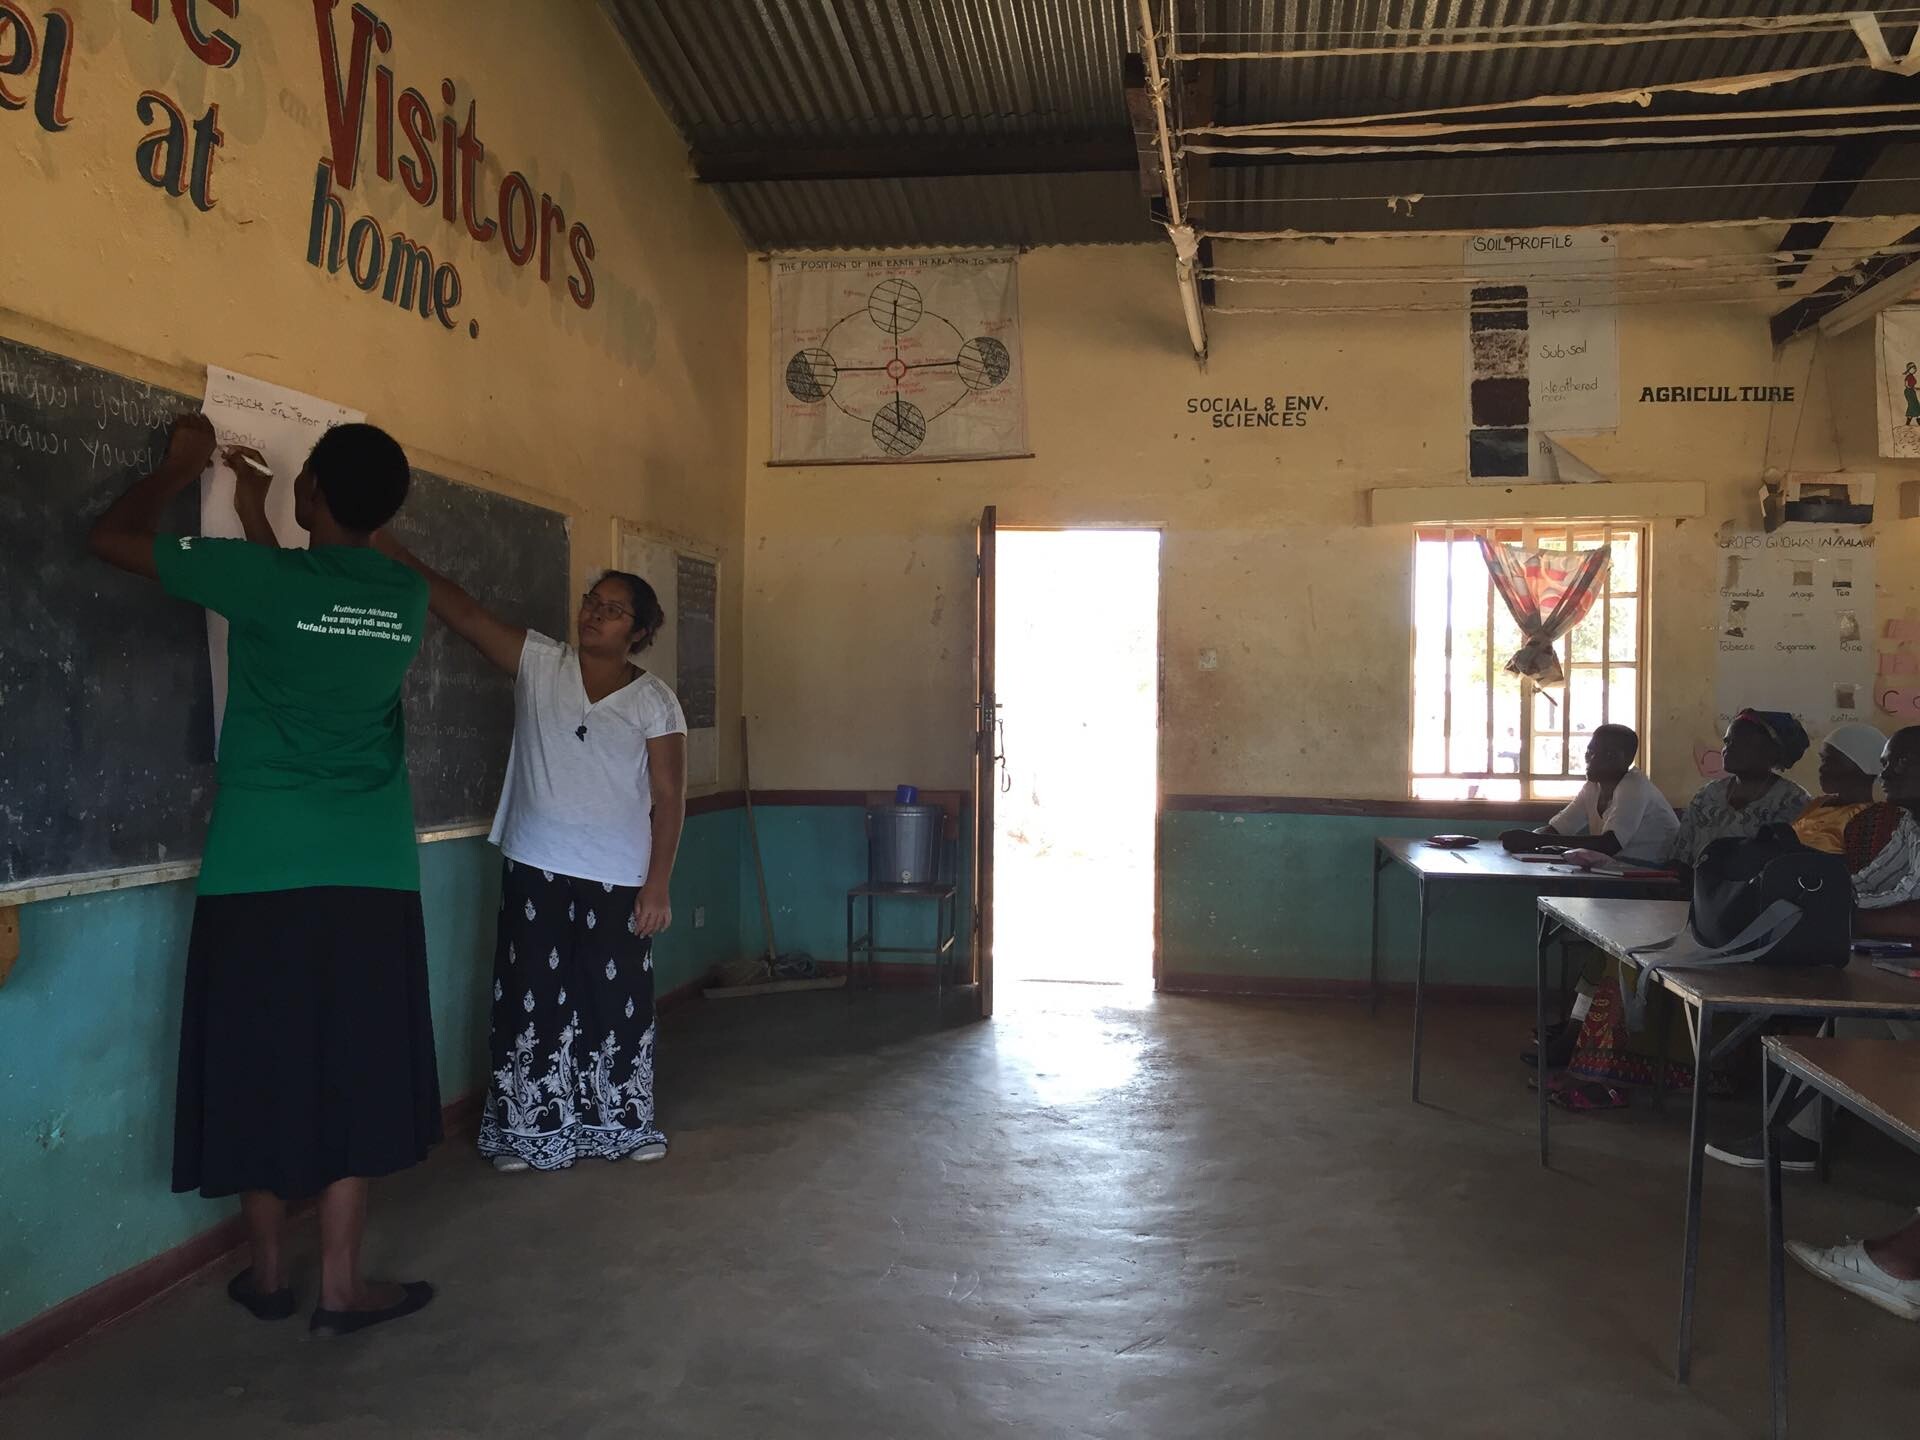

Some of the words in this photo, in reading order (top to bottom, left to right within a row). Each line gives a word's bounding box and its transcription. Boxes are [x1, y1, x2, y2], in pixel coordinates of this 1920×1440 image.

[313, 0, 595, 309] Visitors
[135, 90, 224, 211] at
[307, 157, 481, 338] home.
[1474, 236, 1507, 252] SOIL
[1509, 234, 1573, 252] PROFILE
[779, 263, 796, 273] THE
[800, 261, 847, 271] POSITION
[851, 261, 862, 270] OF
[886, 259, 915, 269] EARTH
[918, 258, 928, 267] IN
[1541, 376, 1599, 394] Weathered
[1638, 385, 1796, 403] AGRICULTURE
[1186, 396, 1258, 414] SOCIAL
[1263, 396, 1277, 412] &
[1285, 395, 1329, 411] ENV.
[1211, 411, 1308, 429] SCIENCES
[1719, 535, 1762, 549] CROPS
[1835, 588, 1850, 597] Tea
[320, 613, 339, 624] kwa
[339, 616, 362, 627] amayi
[363, 617, 375, 627] ndi
[328, 625, 345, 635] kwa
[346, 626, 357, 636] ka
[357, 628, 391, 640] chirombo
[391, 632, 401, 641] ka
[1839, 639, 1863, 652] Rice
